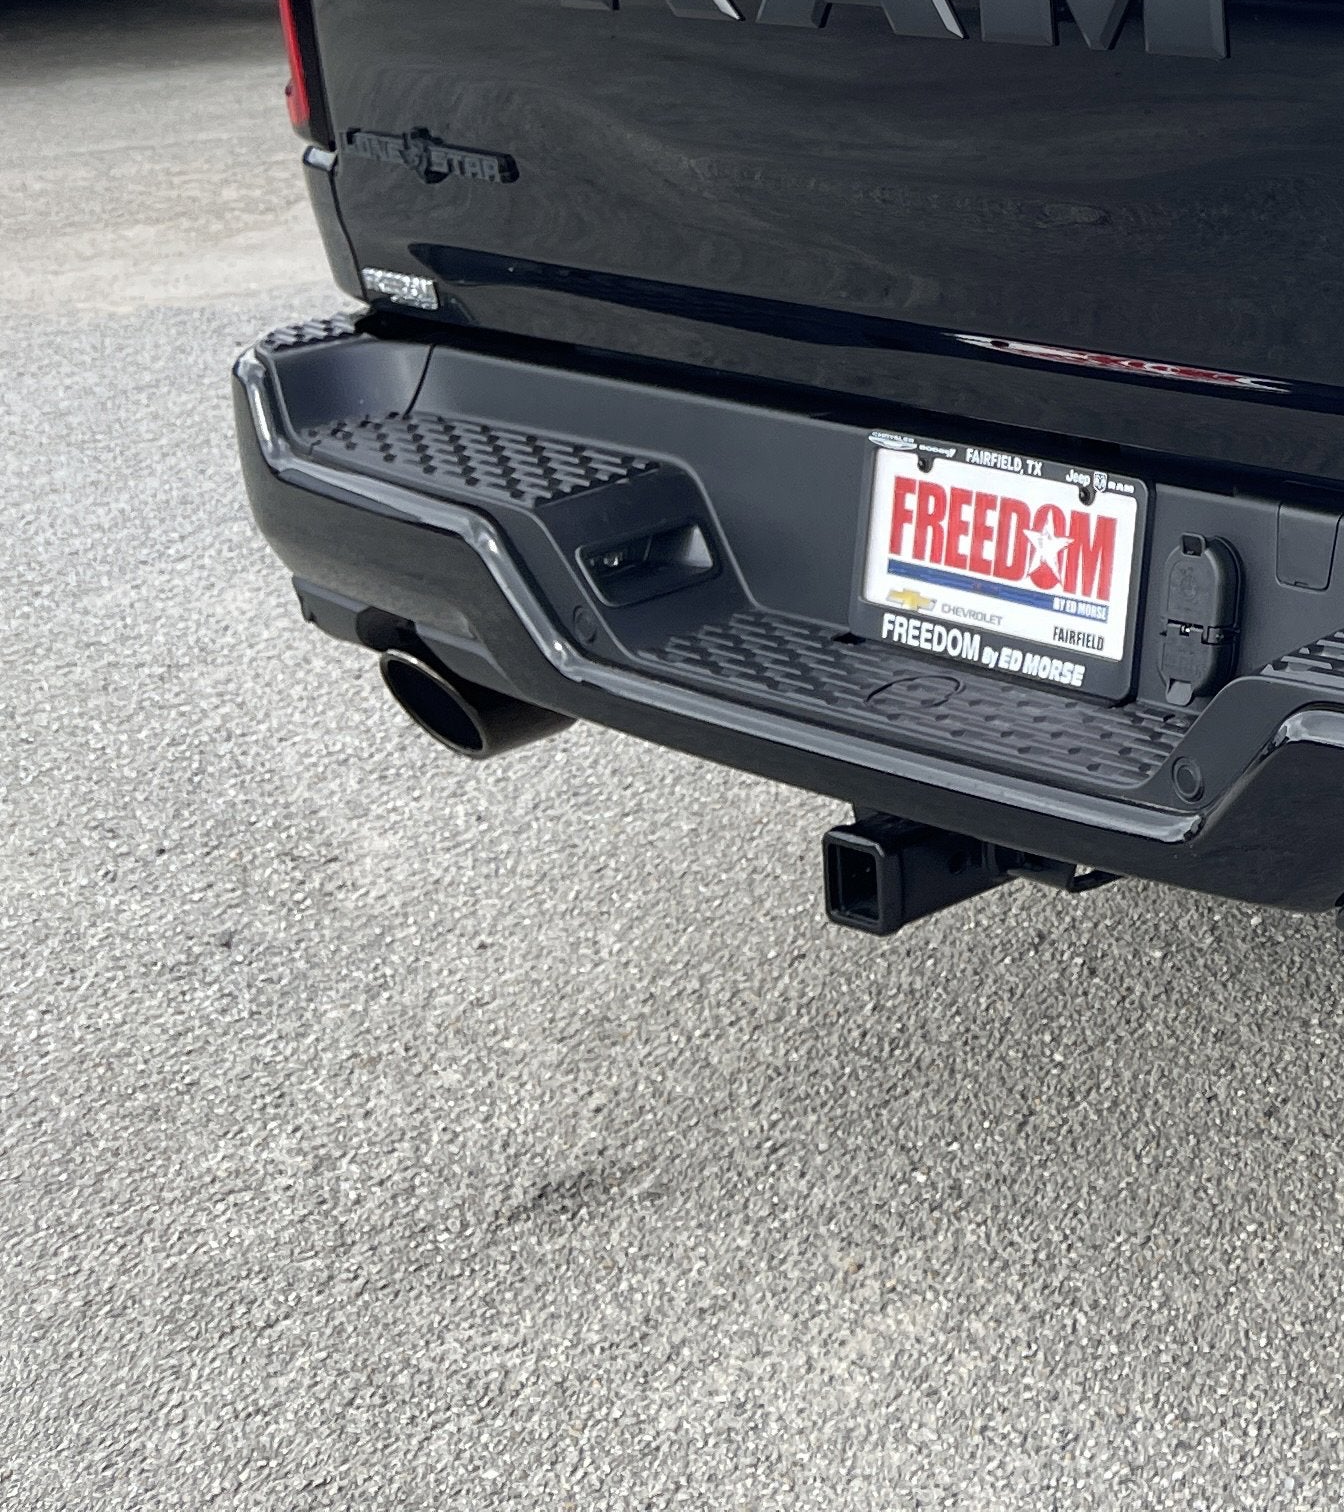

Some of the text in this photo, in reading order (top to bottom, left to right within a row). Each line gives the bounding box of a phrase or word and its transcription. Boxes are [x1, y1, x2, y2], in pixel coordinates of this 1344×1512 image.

[966, 447, 1043, 476] FAIRFIELD, TX
[1065, 469, 1091, 487] Jeep
[889, 475, 1118, 602] FREEDOM
[941, 603, 1003, 626] CHEVROLET
[1053, 597, 1108, 621] BY ED MORSE
[882, 613, 981, 661] FREEDOM
[998, 647, 1023, 672] ED
[1023, 653, 1086, 687] MORSE
[1053, 626, 1104, 650] FAIRFIELD
